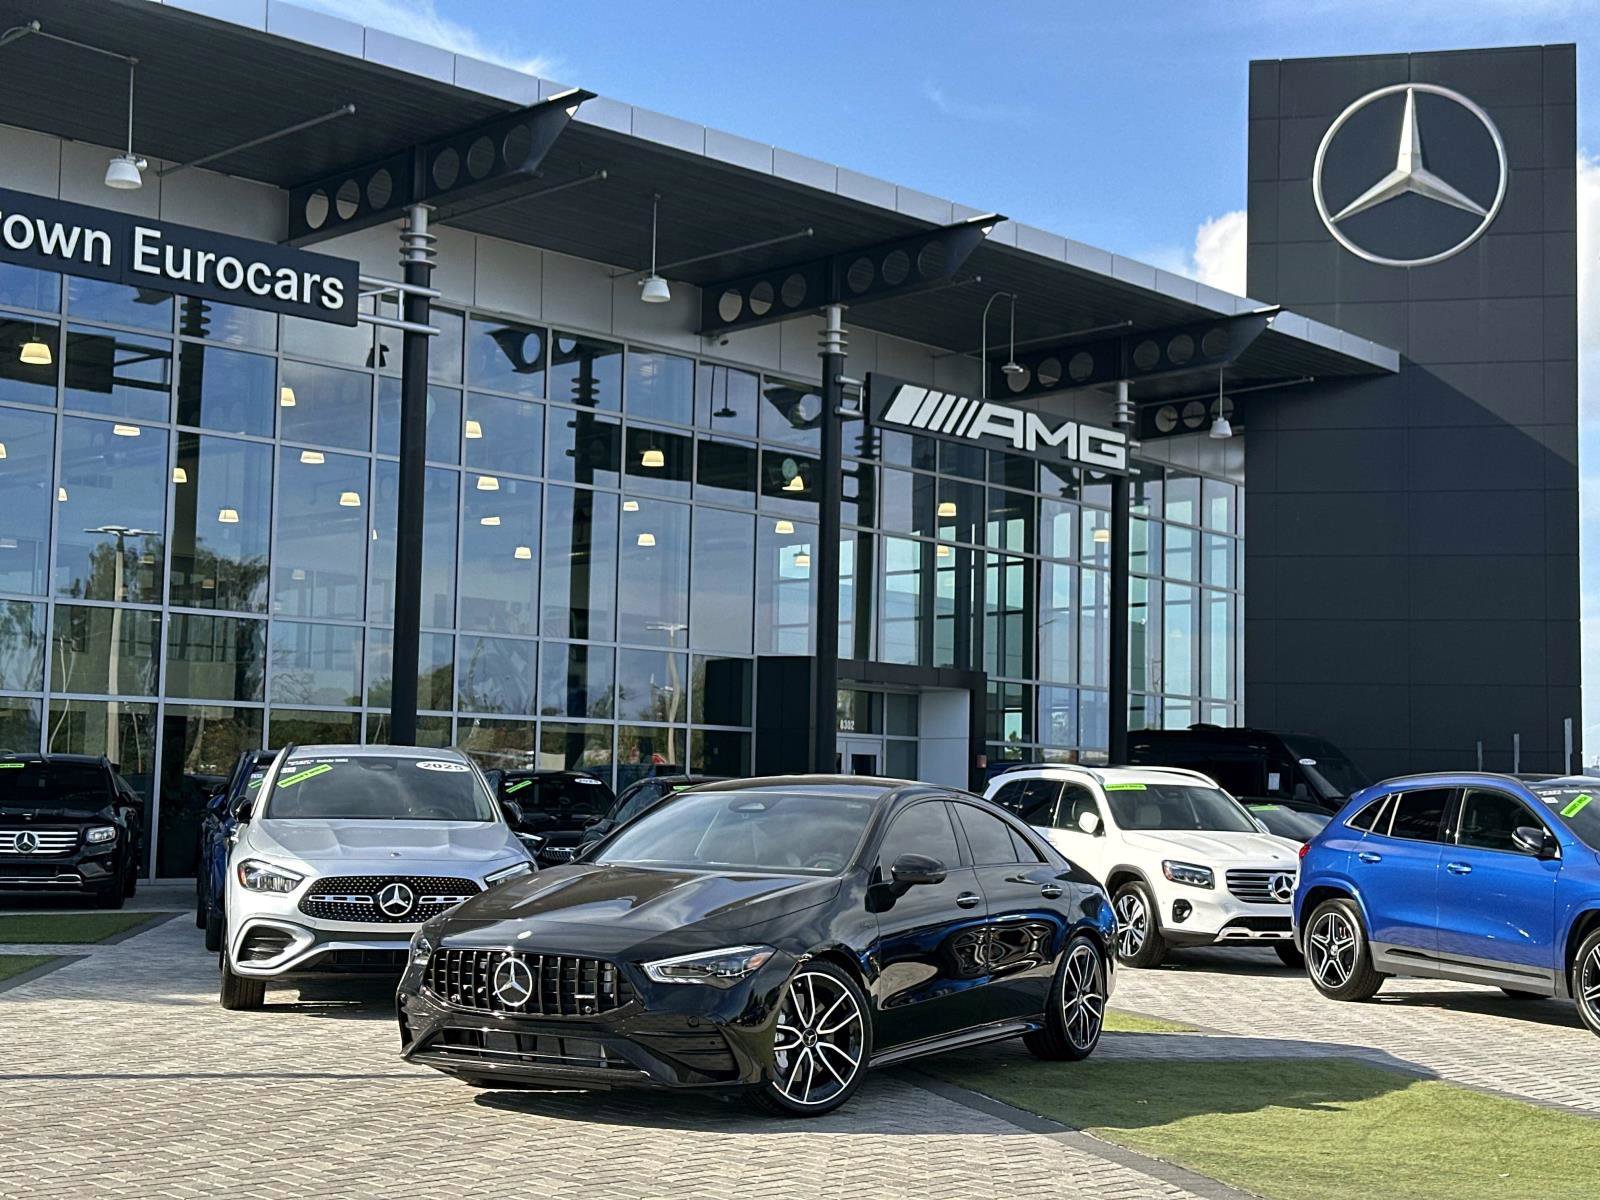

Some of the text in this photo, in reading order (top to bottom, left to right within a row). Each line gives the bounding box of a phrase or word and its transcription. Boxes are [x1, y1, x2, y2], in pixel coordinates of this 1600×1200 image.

[0, 206, 344, 310] own Eurocars
[966, 402, 1126, 470] AMG
[422, 762, 464, 771] 2025
